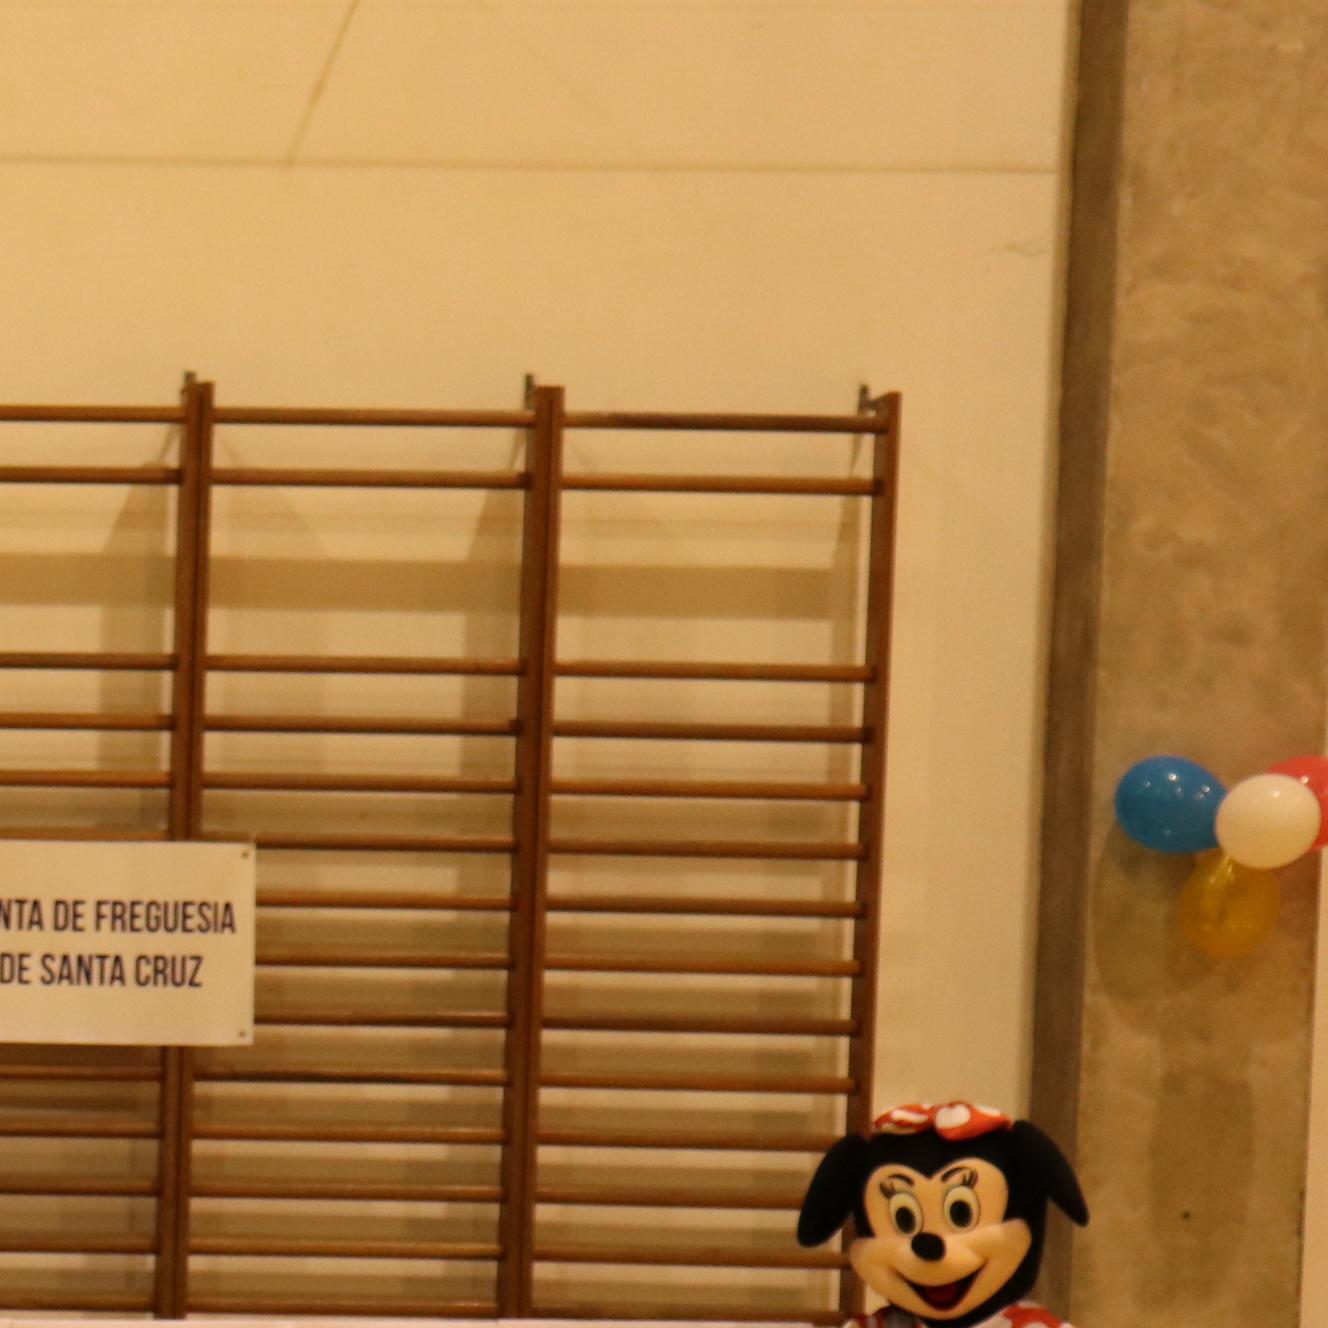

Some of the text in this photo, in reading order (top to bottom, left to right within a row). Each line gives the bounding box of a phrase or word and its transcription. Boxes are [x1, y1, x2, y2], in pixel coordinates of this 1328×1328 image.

[52, 899, 85, 932] DE
[94, 901, 237, 934] FREGUESIA
[41, 954, 127, 986] SANTA
[134, 955, 204, 988] CRUZ
